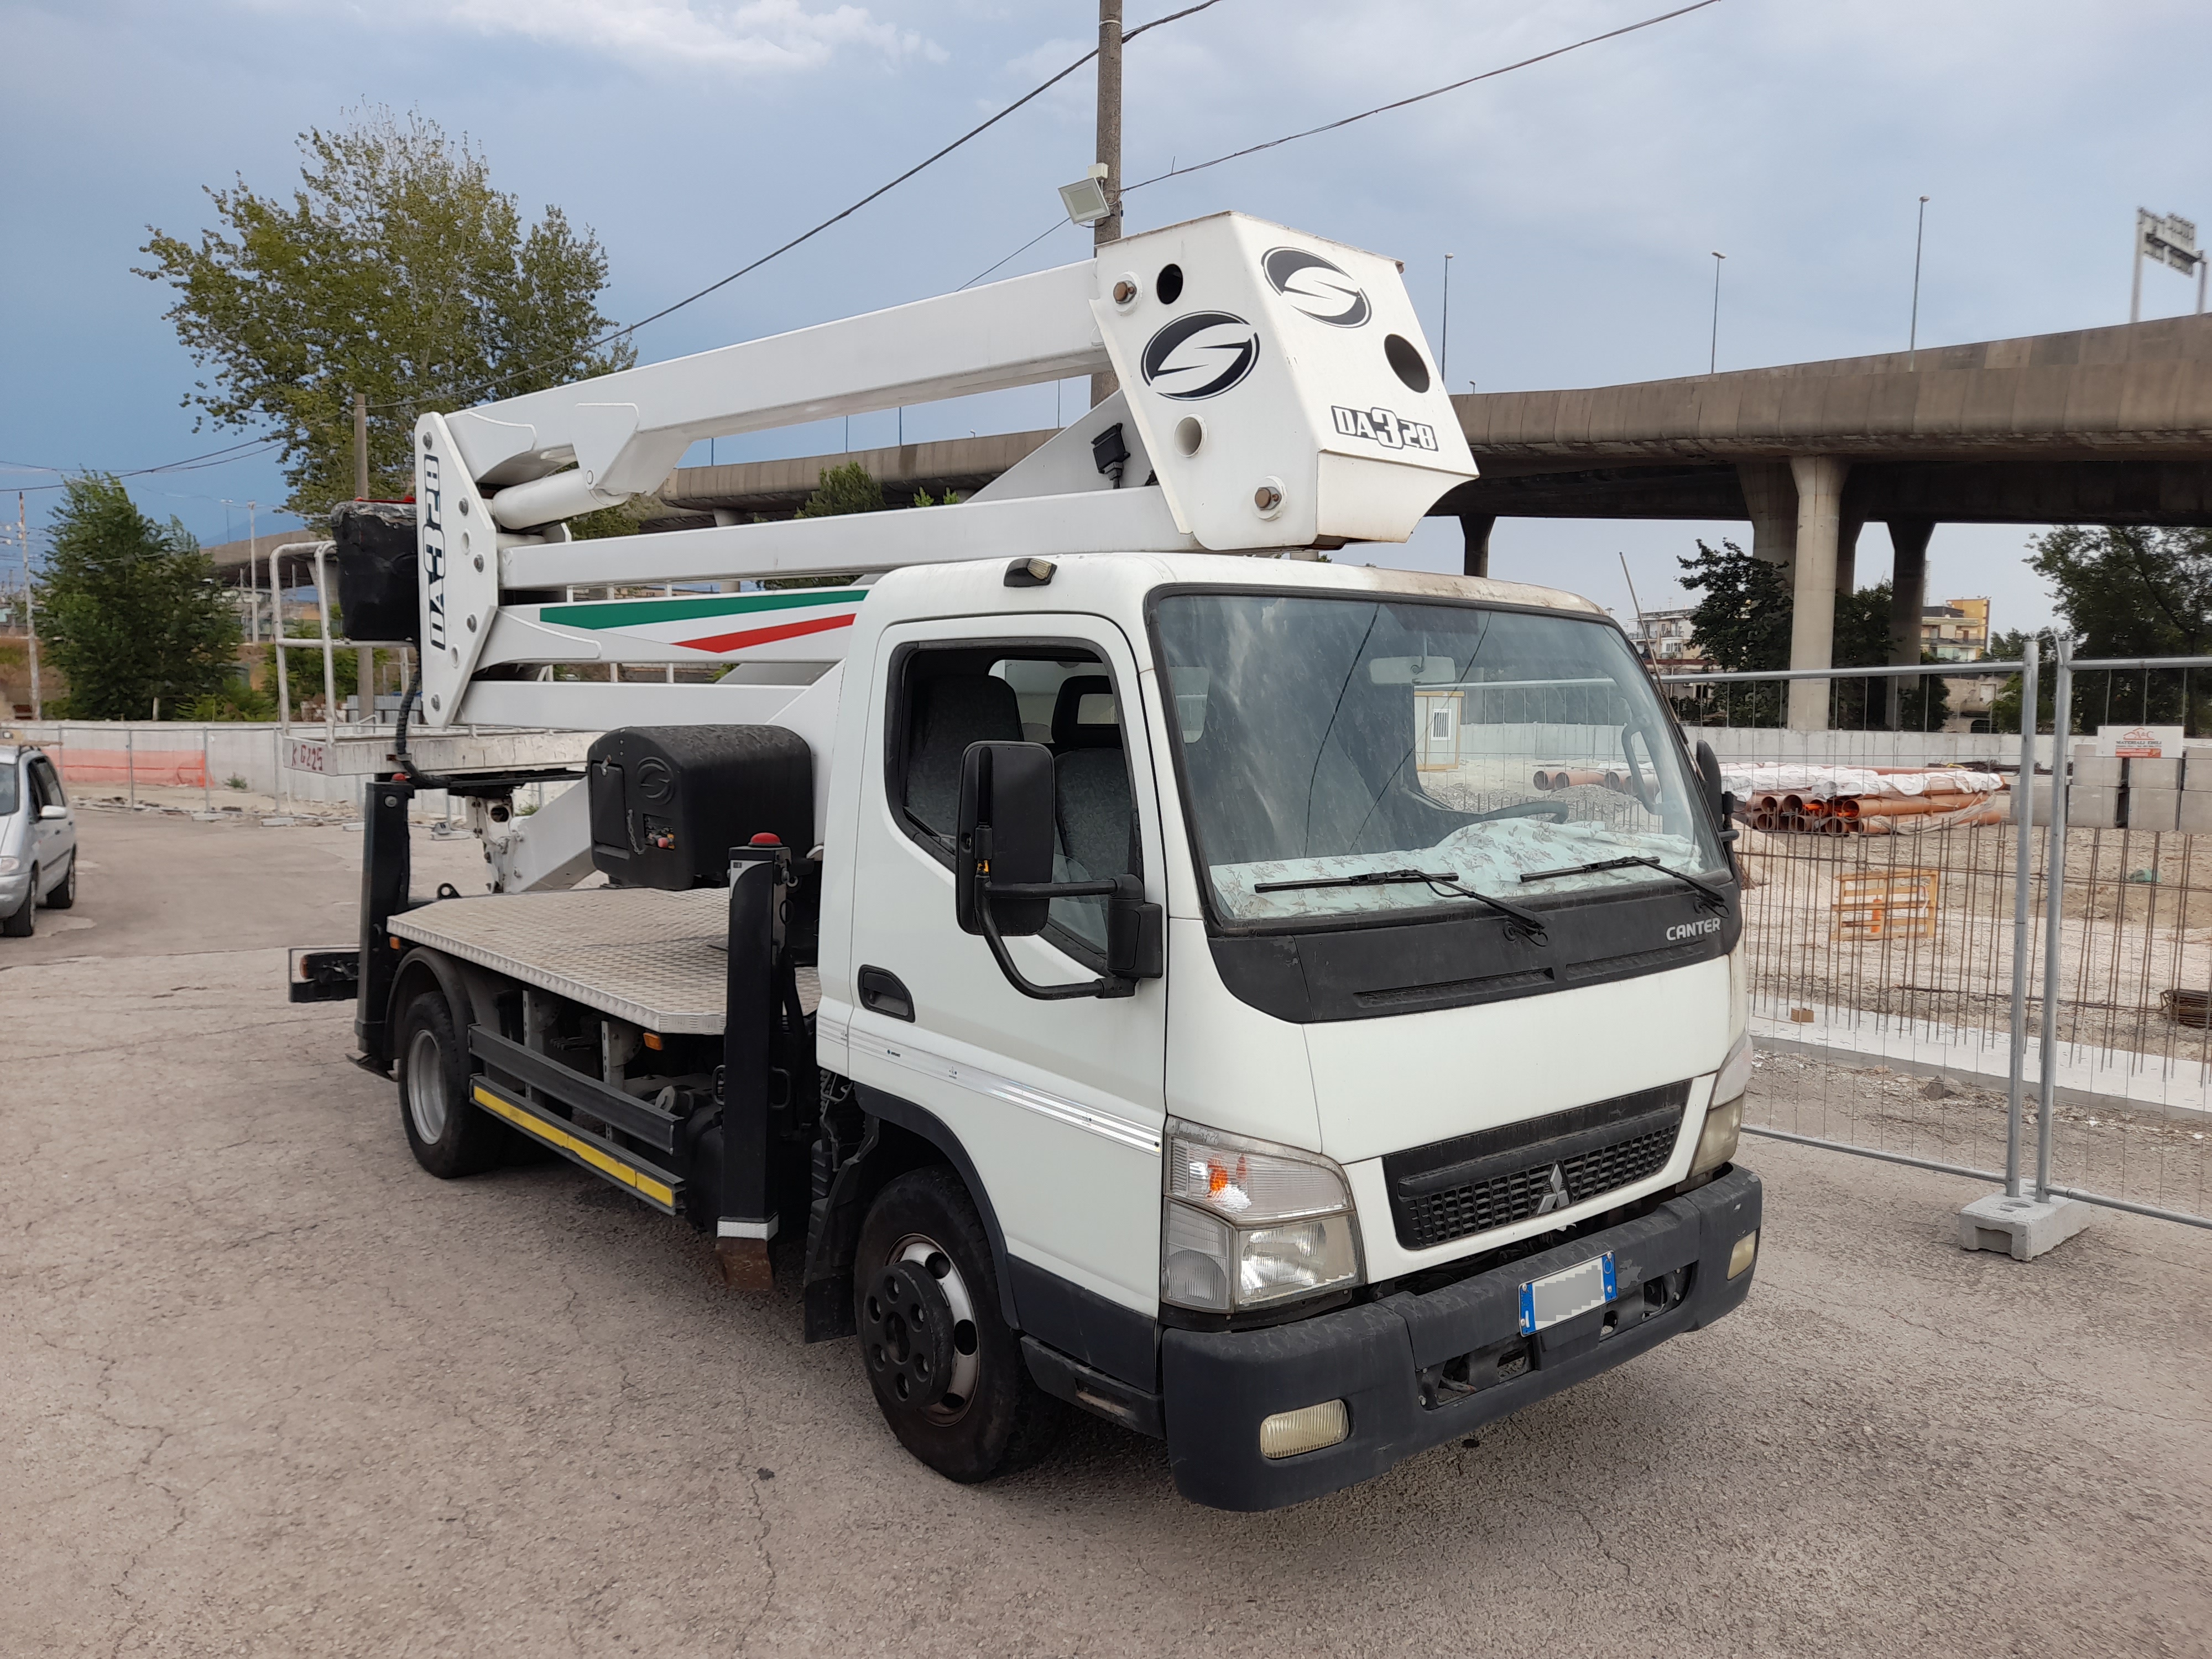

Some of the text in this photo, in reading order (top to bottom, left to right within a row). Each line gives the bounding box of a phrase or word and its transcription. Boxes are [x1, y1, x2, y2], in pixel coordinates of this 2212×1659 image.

[1331, 405, 1438, 452] DA328
[423, 454, 445, 650] DA328
[1666, 917, 1721, 941] CANTER
